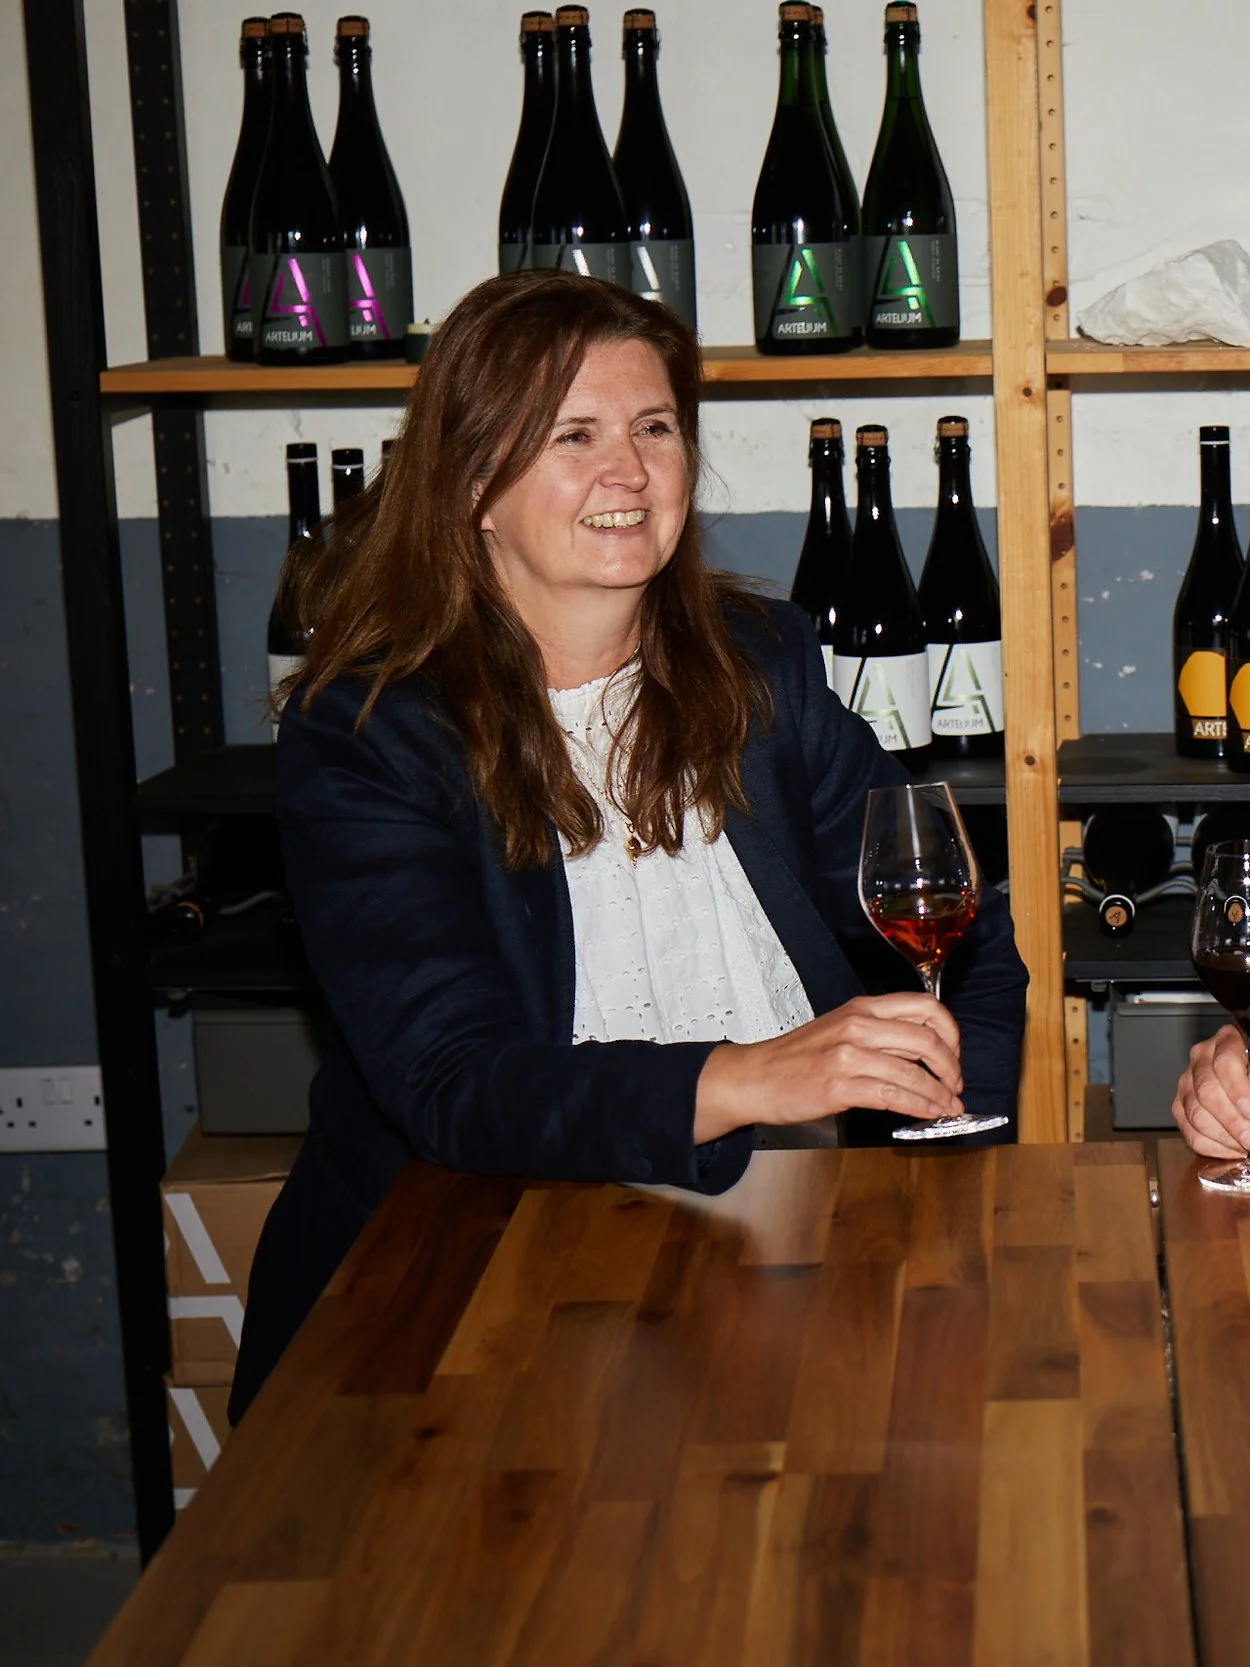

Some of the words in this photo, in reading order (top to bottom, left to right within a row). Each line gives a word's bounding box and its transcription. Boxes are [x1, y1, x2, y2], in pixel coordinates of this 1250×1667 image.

[876, 312, 922, 324] ARTELIUM
[777, 321, 828, 334] ARTELIUM
[265, 330, 313, 343] ARTELIUM
[936, 717, 984, 730] ARTELIUM
